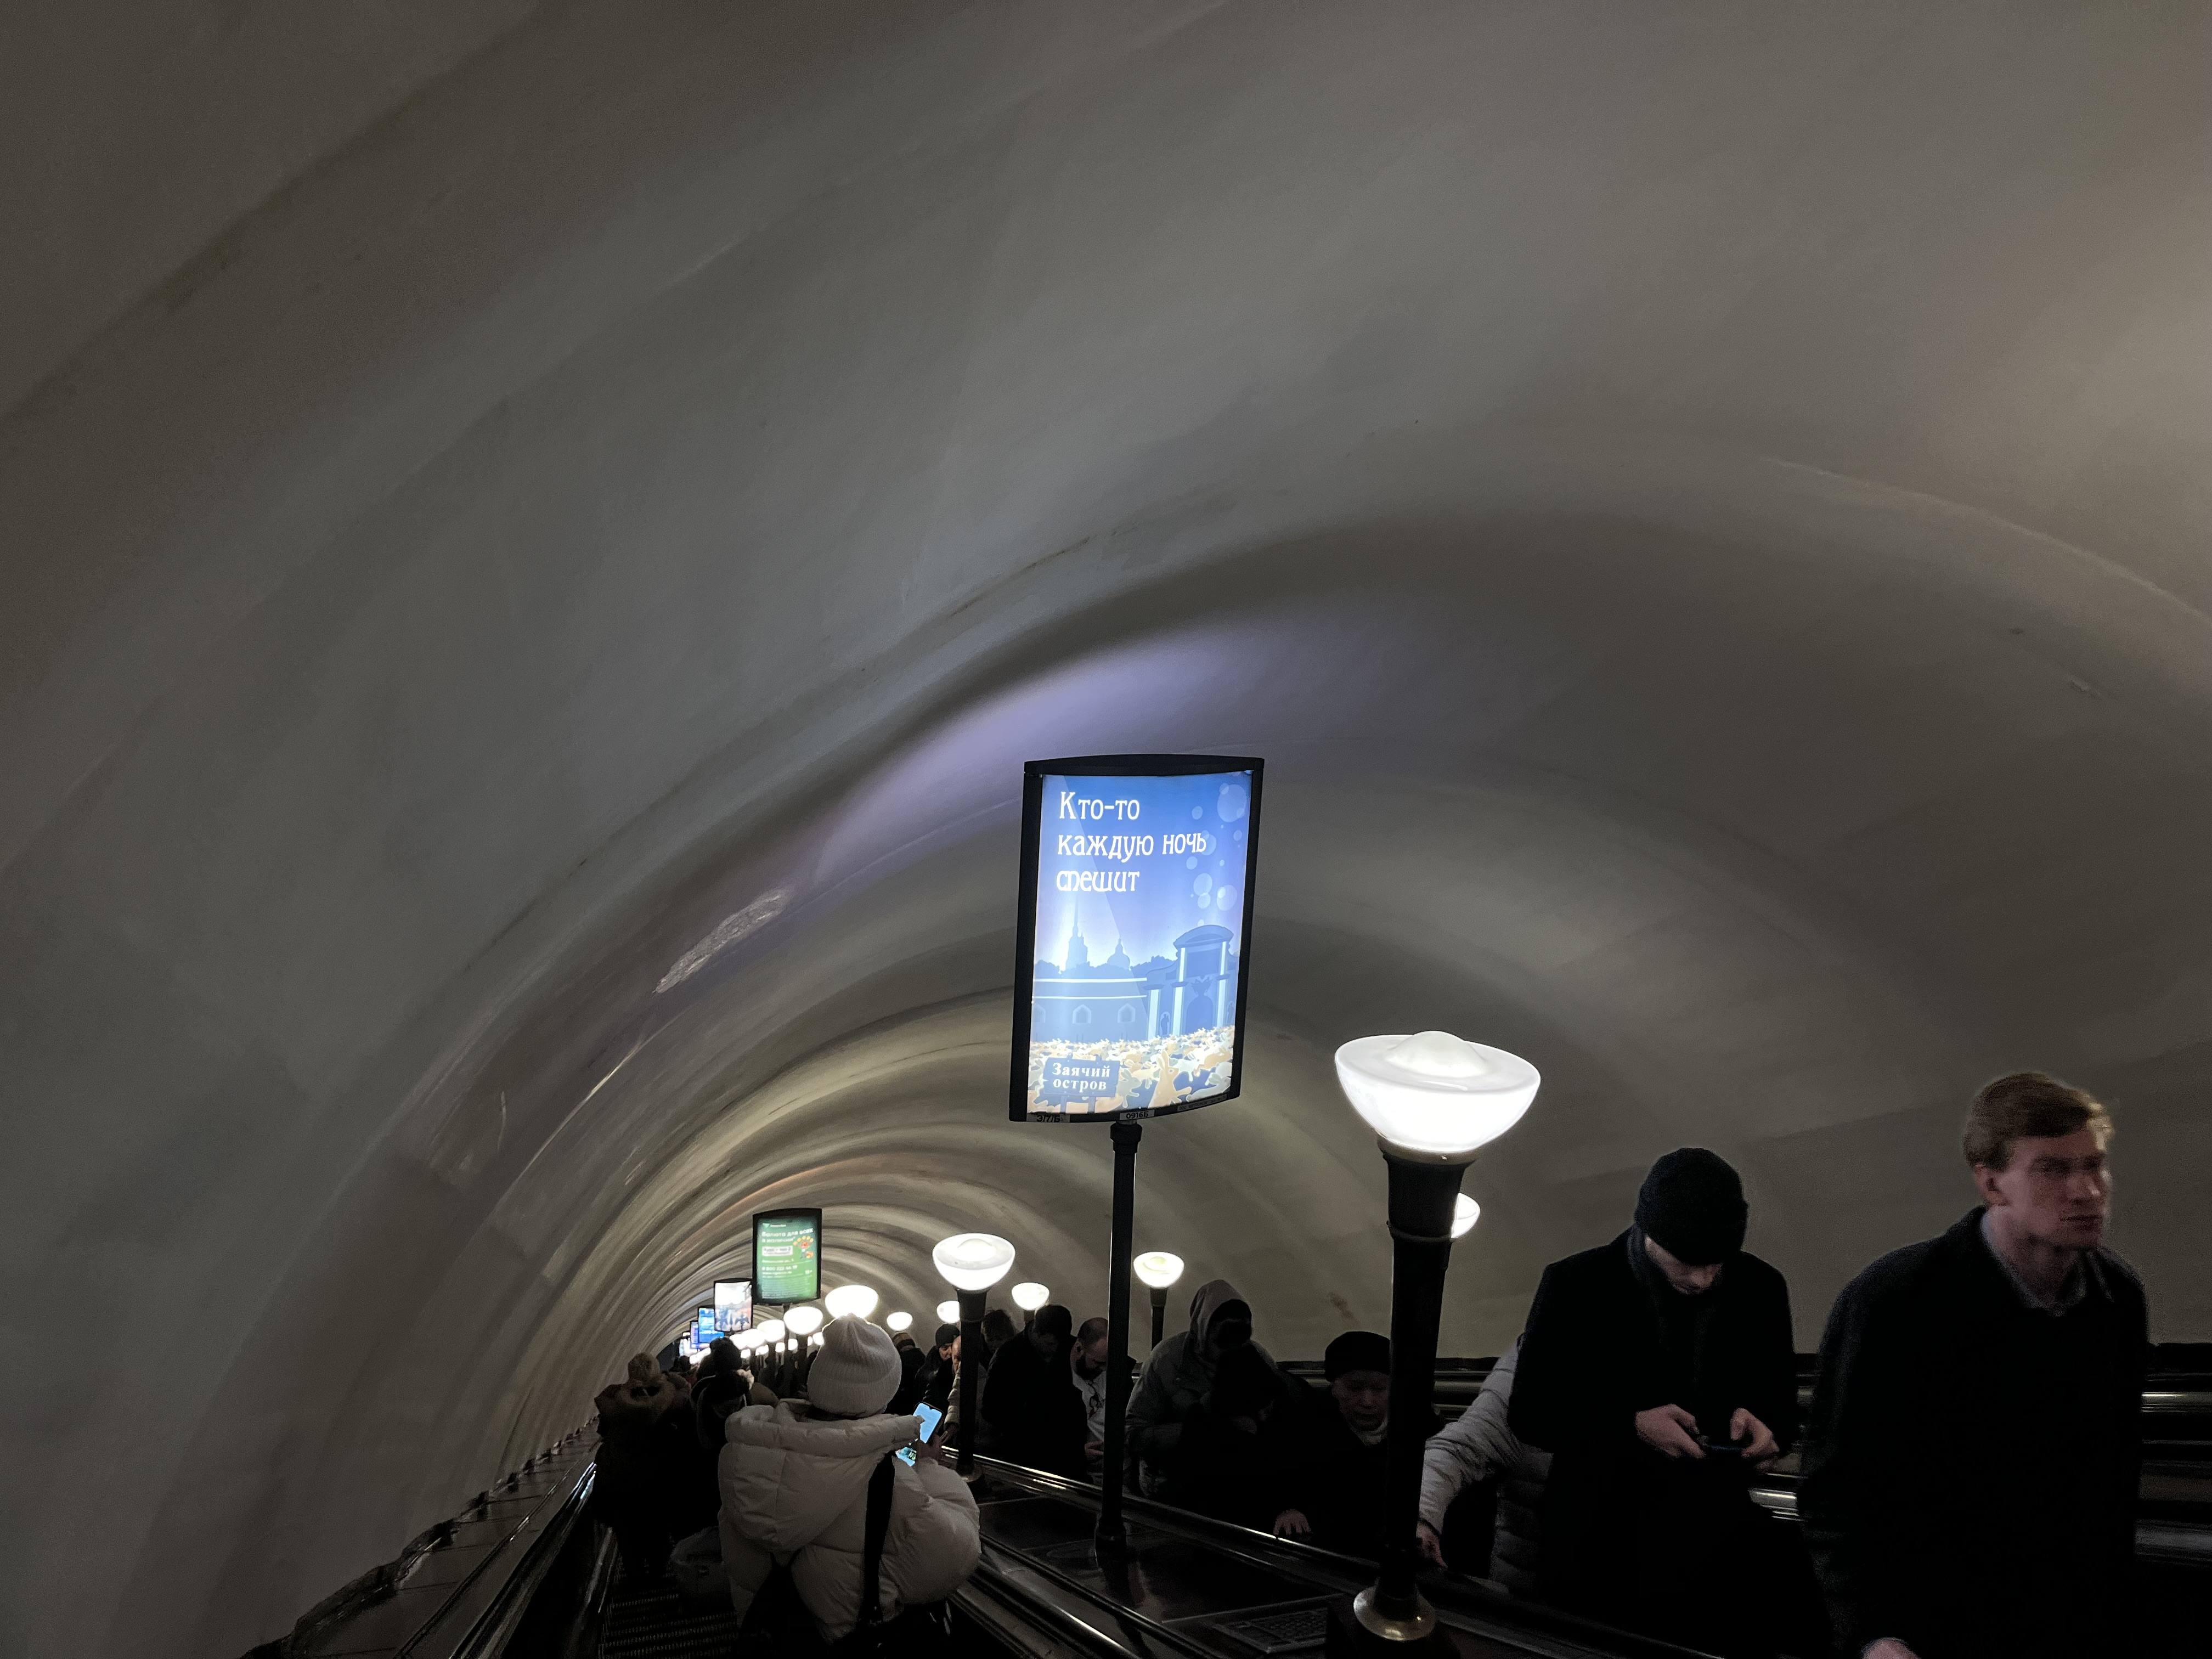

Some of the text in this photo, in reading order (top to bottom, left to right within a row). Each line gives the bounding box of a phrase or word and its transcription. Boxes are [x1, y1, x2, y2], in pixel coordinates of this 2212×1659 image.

[1059, 792, 1140, 820] Кто-то
[1057, 833, 1207, 863] каждую ночь
[1056, 870, 1140, 892] спешит
[1052, 1062, 1110, 1078] Заячий
[1053, 1077, 1107, 1093] остров
